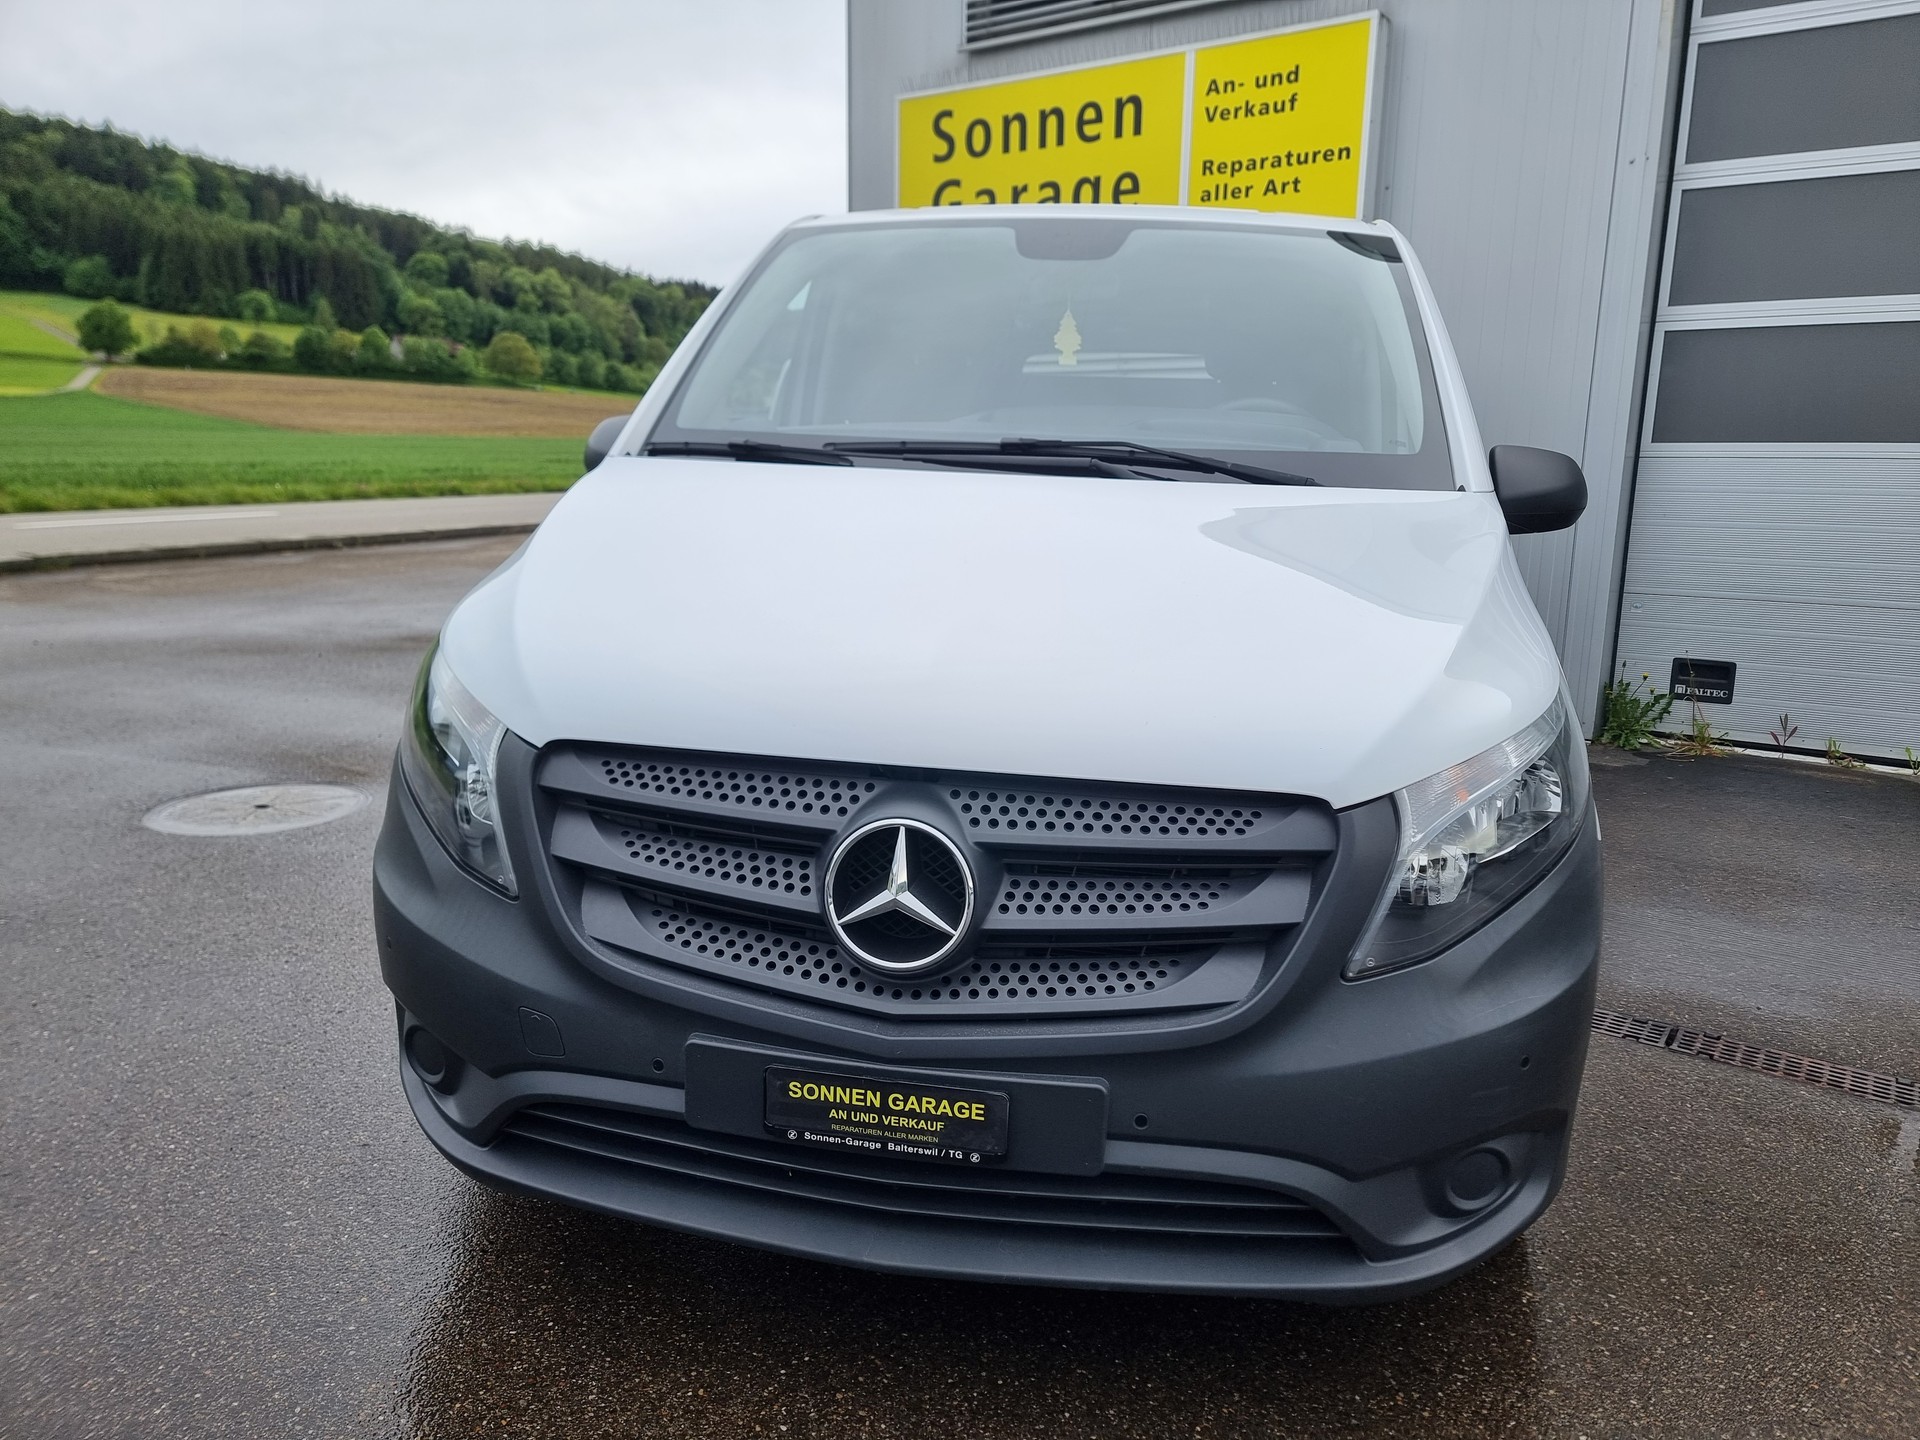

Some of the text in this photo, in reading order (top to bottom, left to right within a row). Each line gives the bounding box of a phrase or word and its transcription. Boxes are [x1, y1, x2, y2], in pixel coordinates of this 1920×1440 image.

[1205, 64, 1300, 97] An- und
[1205, 92, 1298, 123] Verkauf
[931, 91, 1145, 164] Sonnen
[1201, 145, 1351, 178] Reparaturen
[1200, 176, 1301, 203] aller Art
[788, 1081, 985, 1121] SONNEN GARAGE
[829, 1108, 945, 1132] AN UND VERKAUF
[831, 1123, 939, 1143] REPARATUREN ALLER MARKEN
[804, 1131, 882, 1149] Sonnen-Garage
[888, 1142, 938, 1156] Balterswil
[948, 1149, 963, 1160] TG
